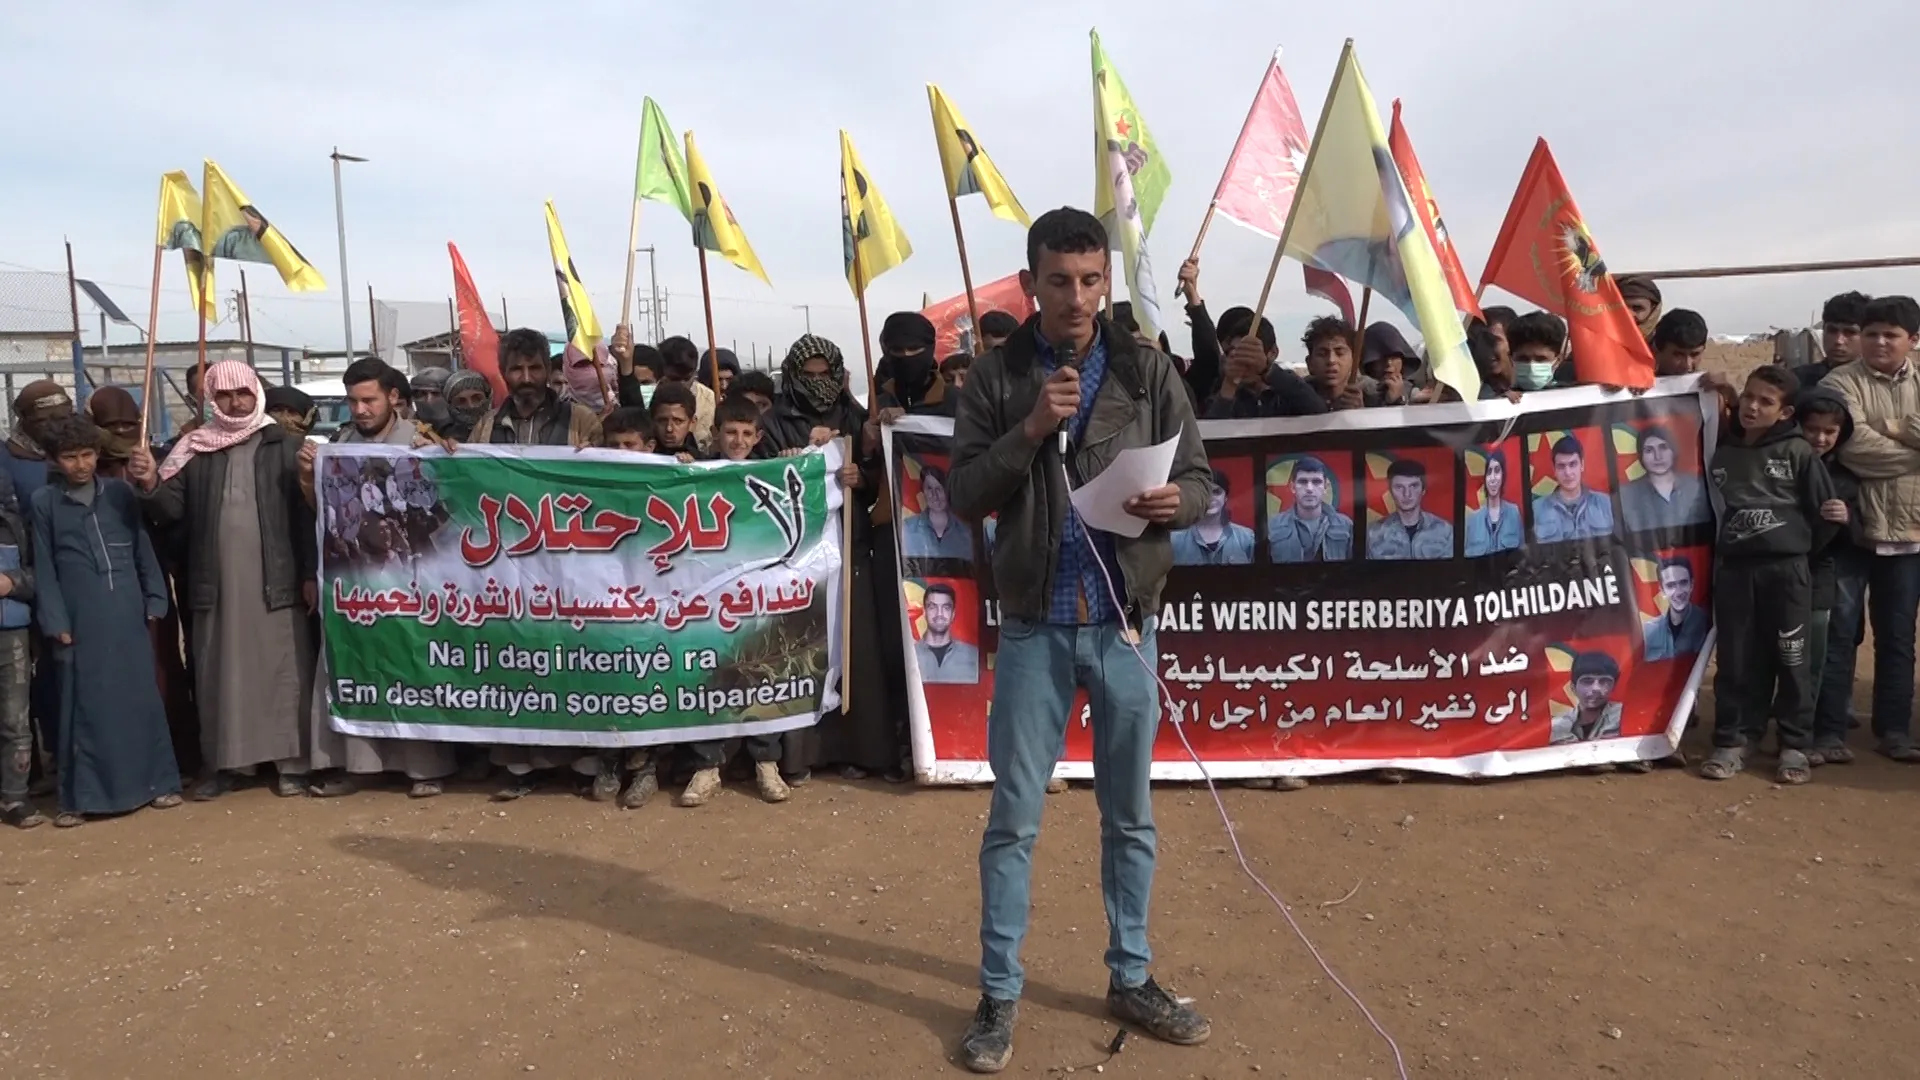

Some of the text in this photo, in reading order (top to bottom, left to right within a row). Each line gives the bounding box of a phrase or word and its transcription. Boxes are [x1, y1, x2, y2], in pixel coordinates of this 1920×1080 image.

[460, 464, 803, 575] لا للإحتلال
[333, 576, 817, 632] لندافع عن مكتسبات الثورة ونحميها
[1153, 592, 1203, 631] ALÊ
[1211, 600, 1297, 631] WERIN
[1306, 597, 1468, 630] SEFERBERIYA
[1474, 565, 1620, 624] TOLHILDANÊ
[429, 641, 465, 668] Na
[473, 643, 490, 674] ji
[684, 648, 718, 670] ra
[1343, 648, 1468, 681] الأسلحة
[1480, 646, 1529, 677] ضد
[337, 676, 815, 716] Em destkeftiyên şoreşê biparêzin
[1208, 695, 1268, 731] أجل
[1324, 696, 1403, 729] العام
[1410, 692, 1477, 731] نفير
[1485, 688, 1529, 725] إلى
[1276, 700, 1317, 730] من
